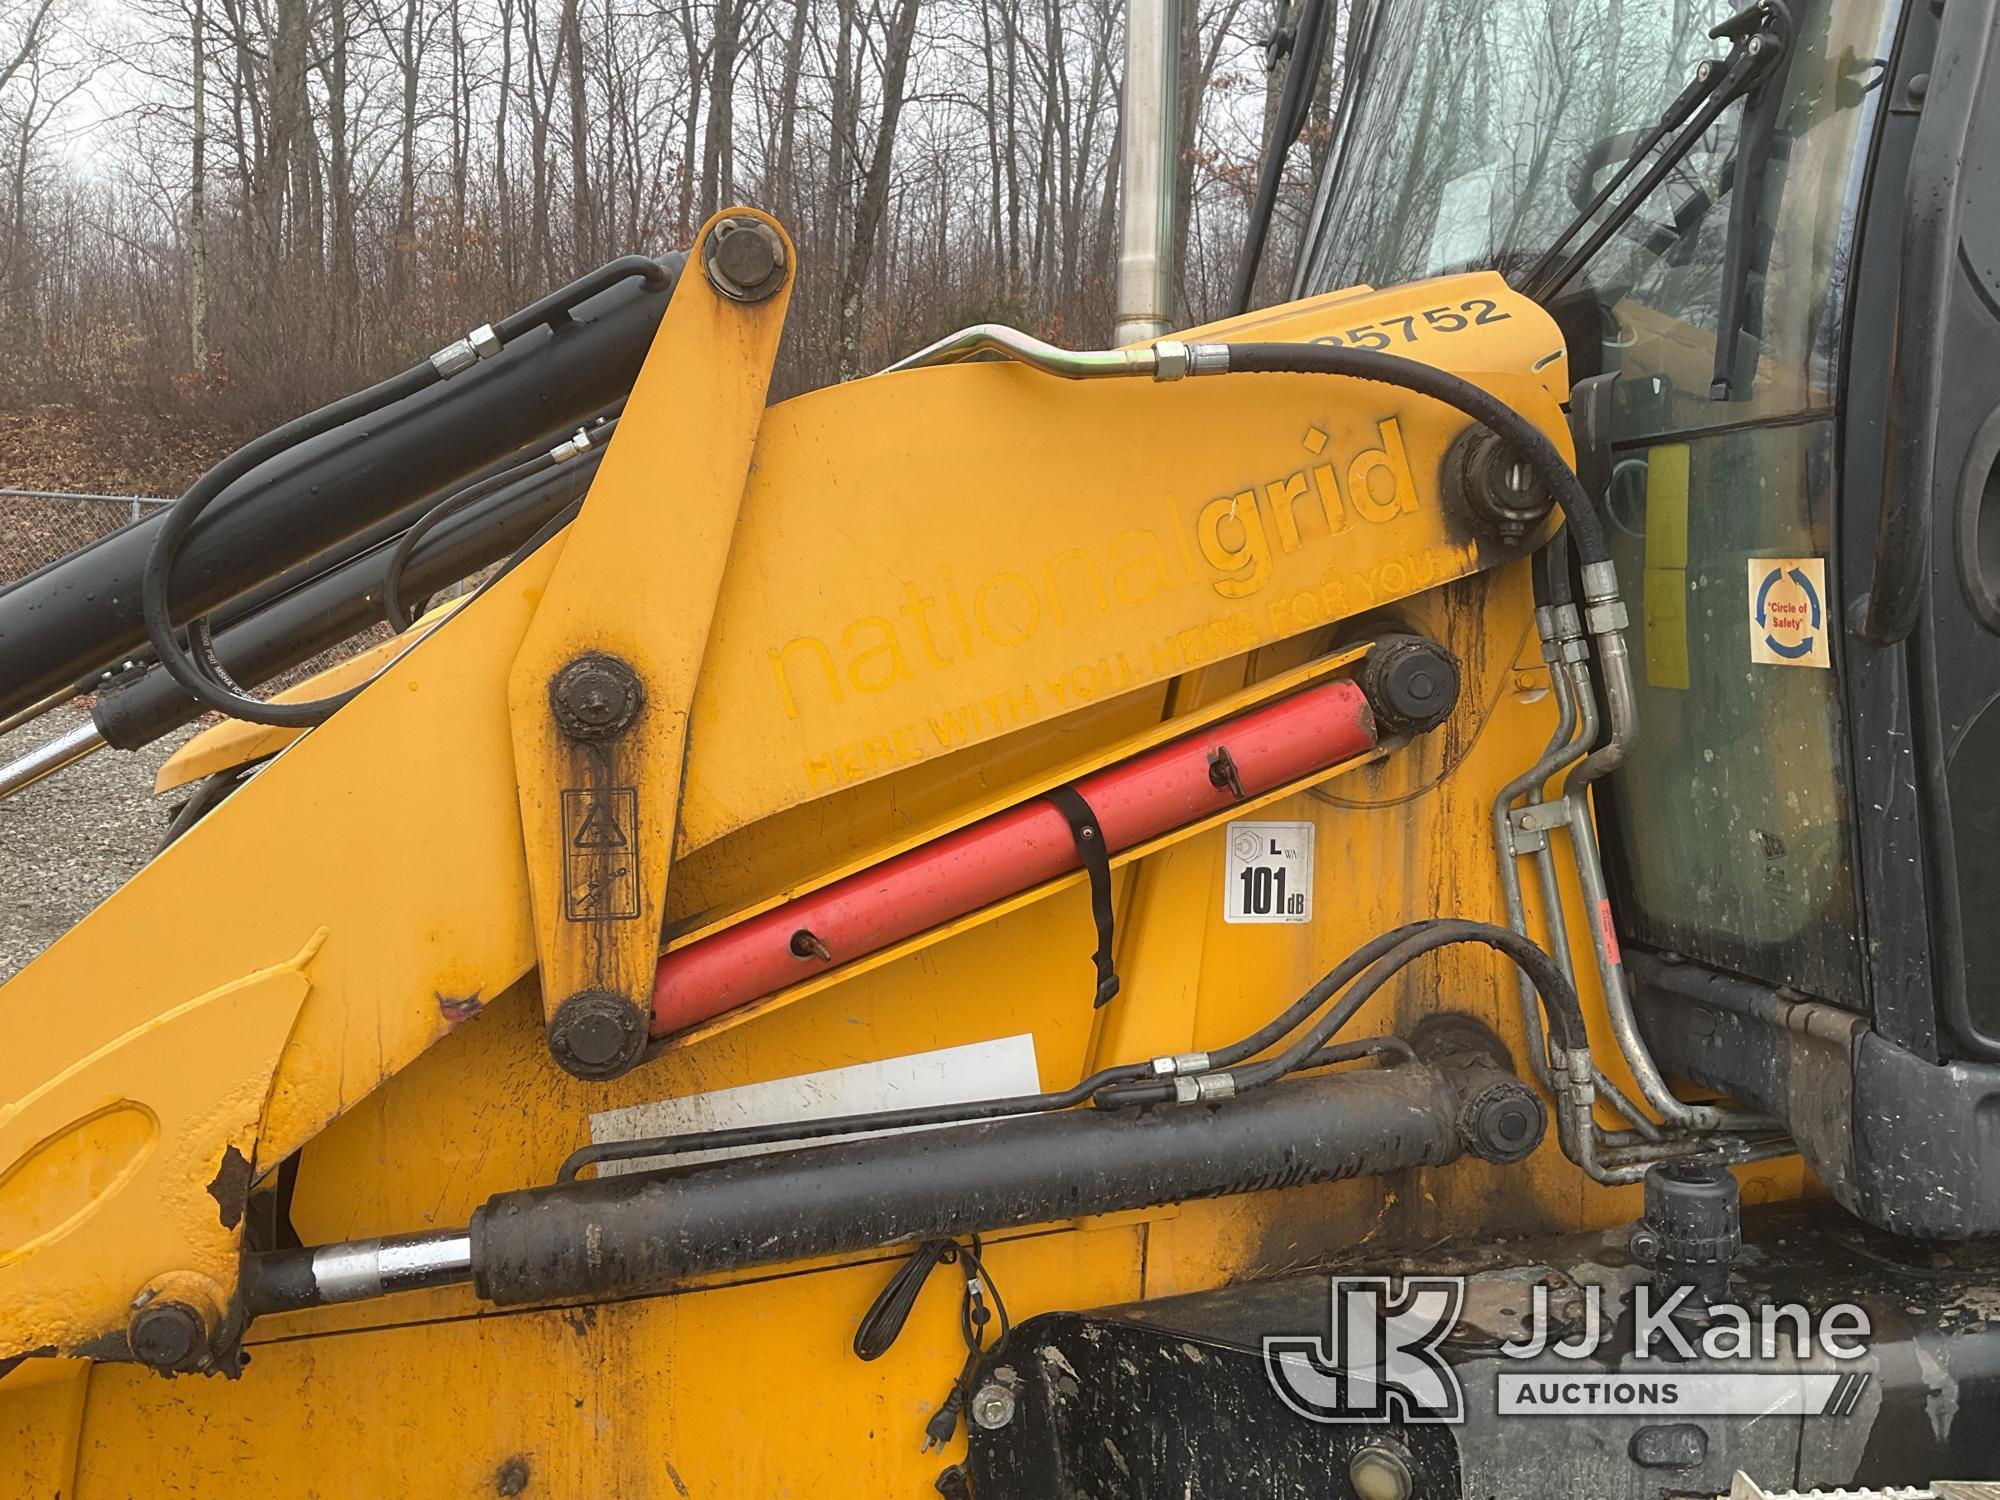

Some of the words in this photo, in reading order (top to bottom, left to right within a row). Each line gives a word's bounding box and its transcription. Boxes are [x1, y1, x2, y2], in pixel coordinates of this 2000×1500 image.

[768, 417, 1420, 721] nationalgrid
[1768, 602, 1796, 613] "Circle
[1798, 602, 1808, 613] of
[1772, 616, 1804, 631] Safety"
[804, 724, 924, 792] HERE
[927, 684, 1039, 747] WITH
